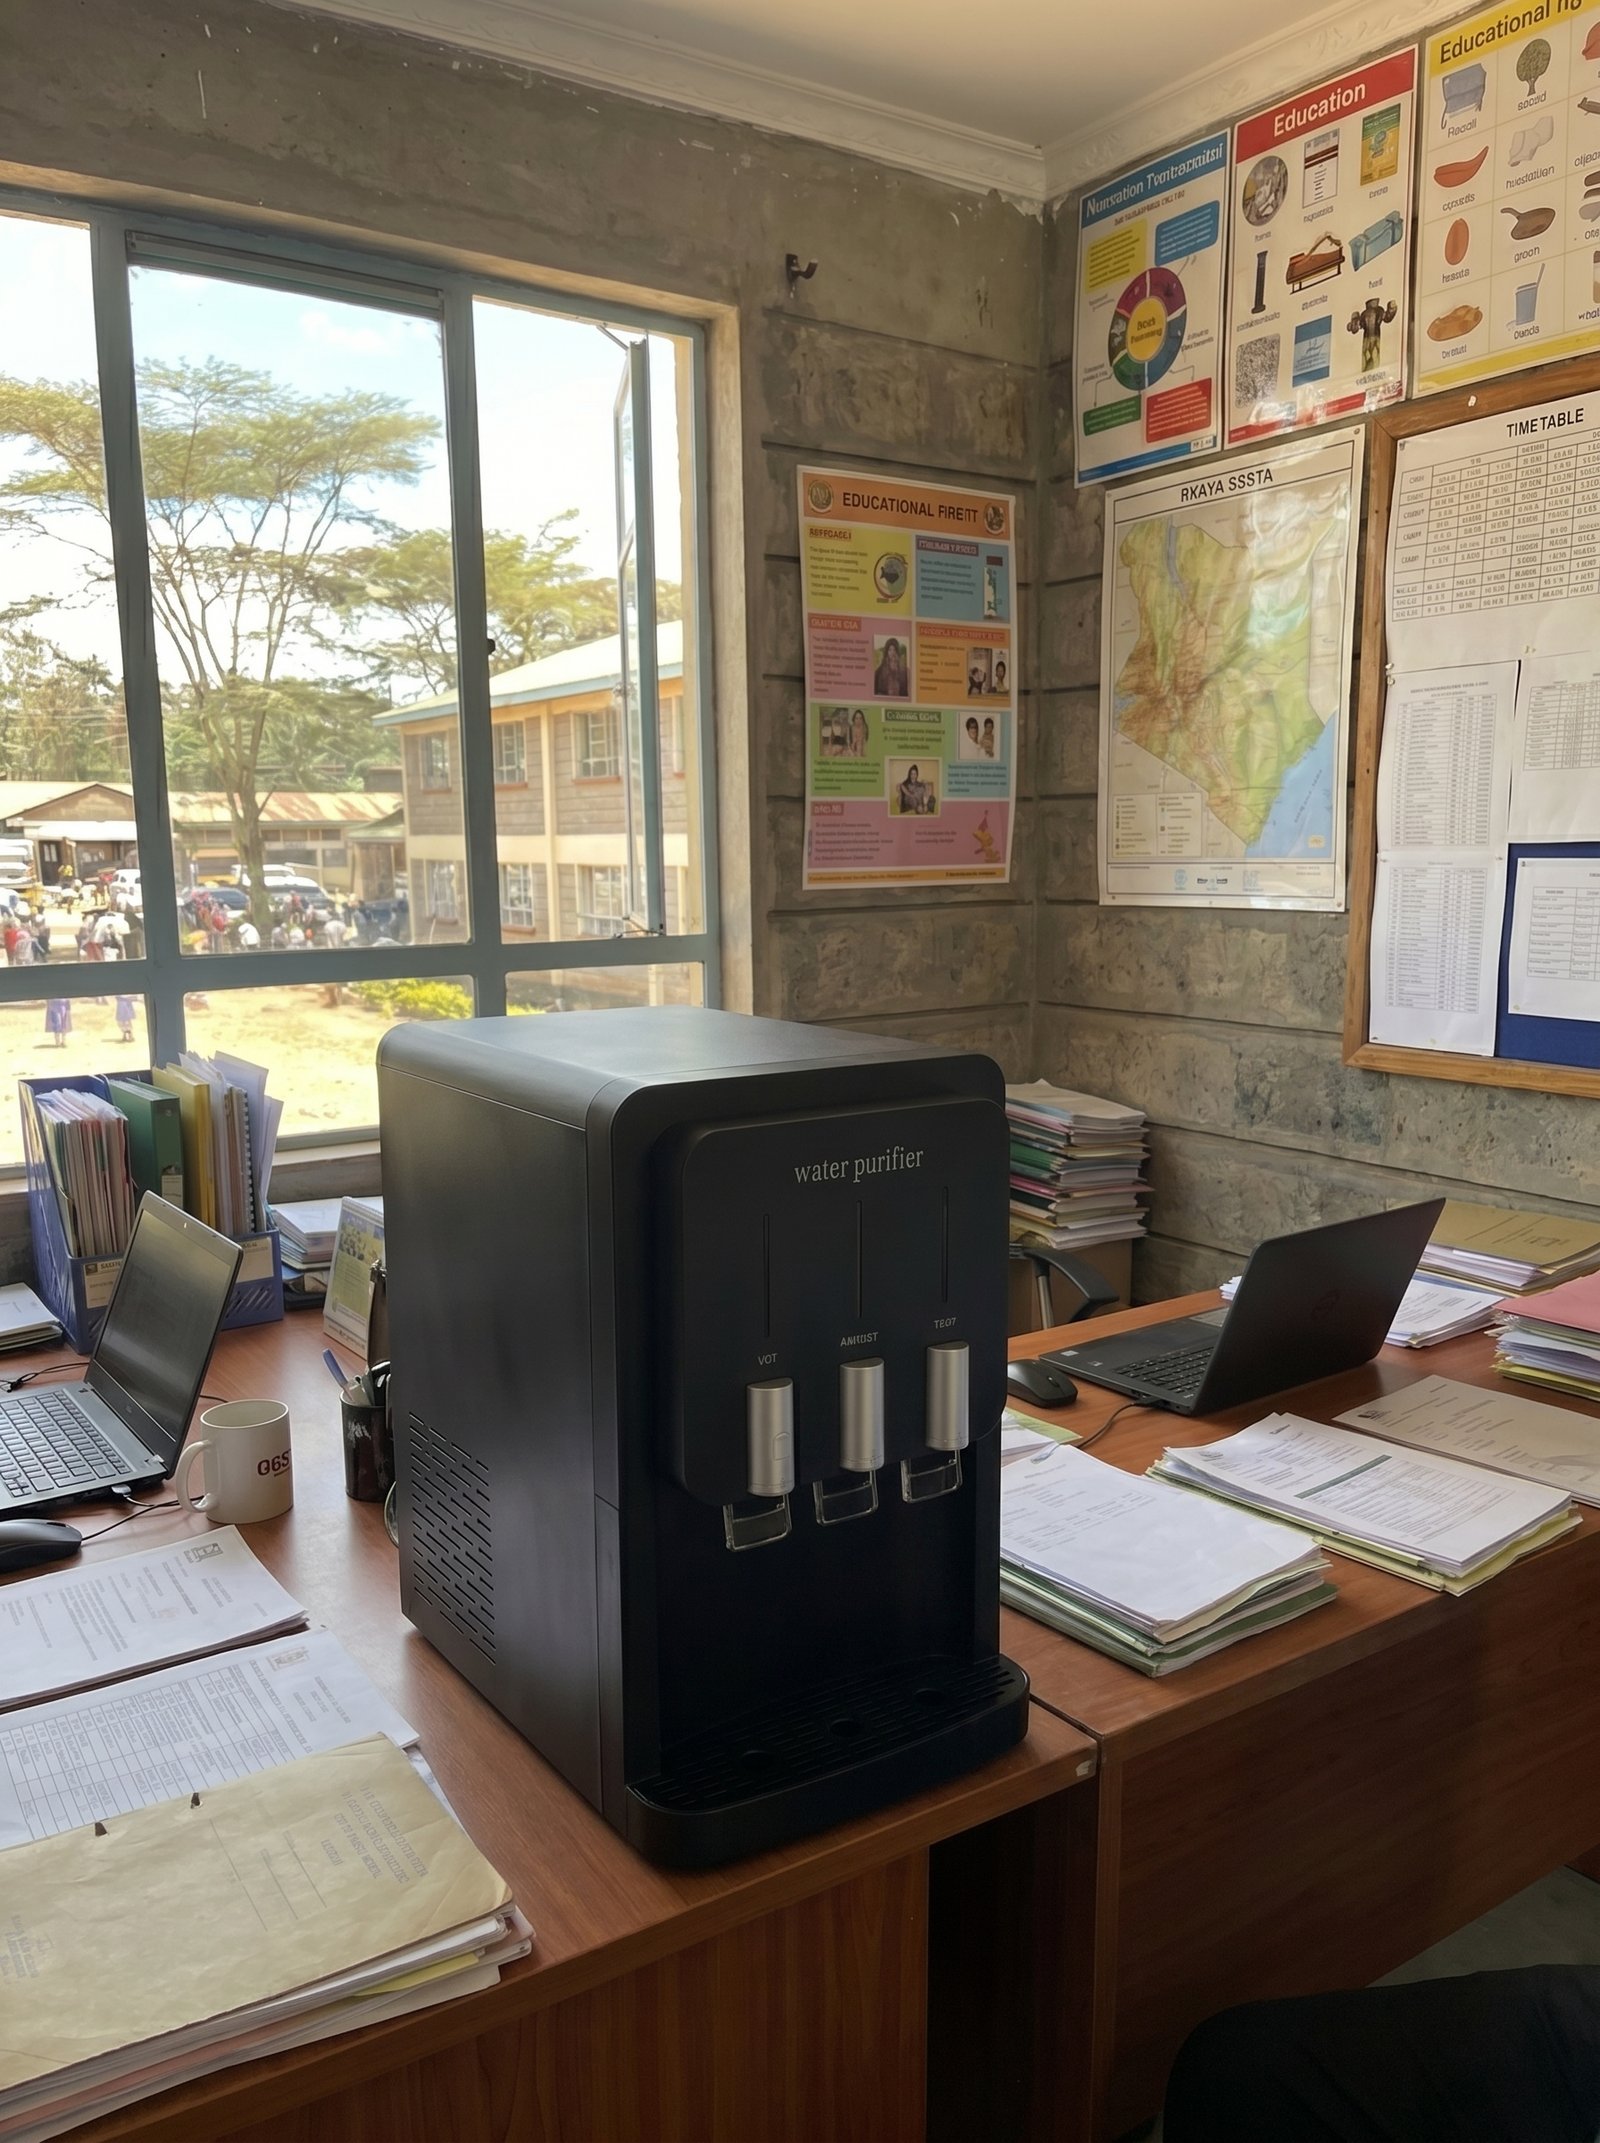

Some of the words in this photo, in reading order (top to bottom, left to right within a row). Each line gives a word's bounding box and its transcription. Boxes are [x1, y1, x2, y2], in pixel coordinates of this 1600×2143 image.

[1440, 0, 1550, 64] Educational
[1273, 83, 1366, 137] Education
[1228, 468, 1273, 491] SSSTA
[842, 492, 934, 517] EDUCATIONAL
[794, 1159, 849, 1184] water
[853, 1146, 924, 1184] purifier
[757, 1353, 778, 1366] VOT
